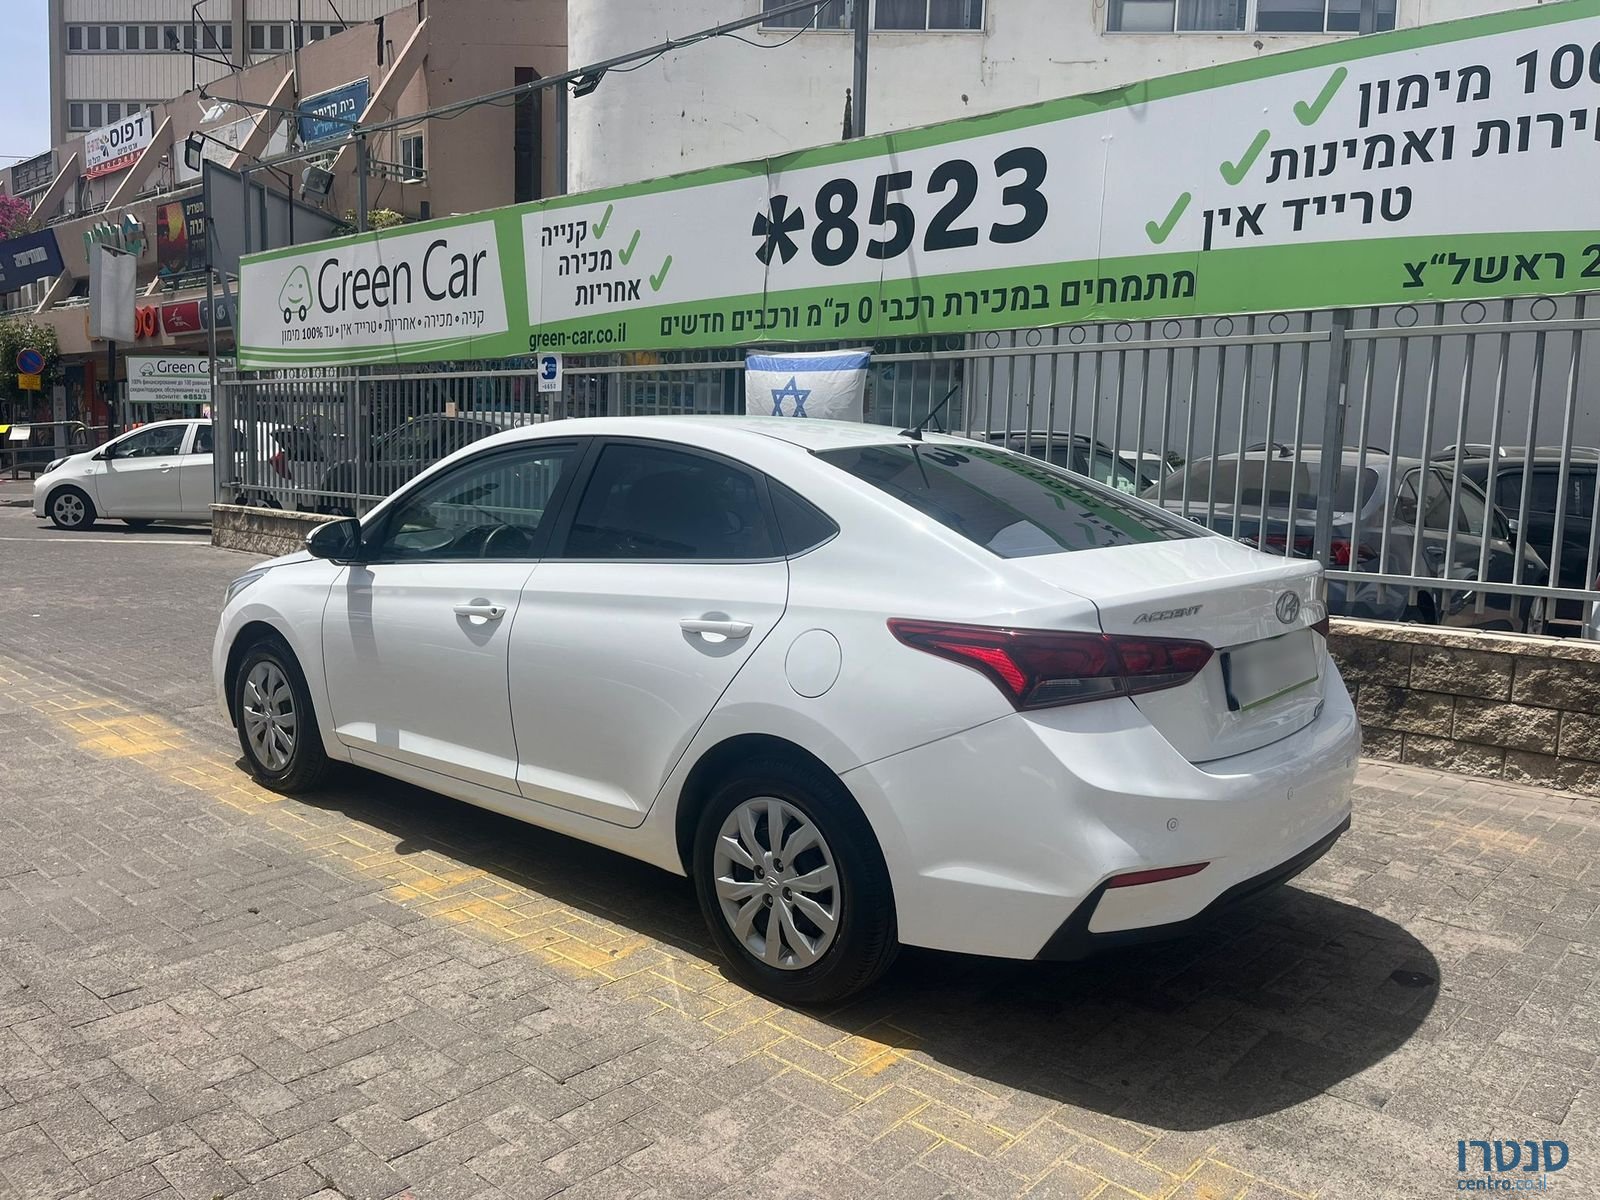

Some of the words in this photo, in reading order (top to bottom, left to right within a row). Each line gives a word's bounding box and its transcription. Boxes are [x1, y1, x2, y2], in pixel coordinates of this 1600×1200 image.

[1516, 41, 1600, 94] 10
[340, 98, 355, 113] בית
[1358, 65, 1491, 128] מימון
[109, 117, 144, 148] דפוס
[1472, 107, 1600, 158] ירות
[1265, 125, 1456, 184] ואמינות
[1282, 186, 1413, 233] טרייד
[541, 220, 588, 248] קנייה
[1202, 202, 1268, 252] אין
[559, 248, 613, 276] מכירה
[317, 257, 412, 315] Green
[422, 239, 487, 301] Car
[1060, 270, 1196, 307] מתמחים
[575, 278, 642, 307] אחריות
[942, 284, 1051, 318] במכירת
[424, 312, 453, 329] מכירה
[461, 310, 485, 329] קניה
[731, 307, 800, 332] ורכבים
[858, 296, 874, 324] 0
[880, 295, 935, 322] רכבי
[281, 329, 300, 345] מימון
[302, 326, 323, 341] 100%
[324, 325, 334, 338] עד
[340, 323, 353, 340] אין
[354, 320, 377, 335] טרייד
[384, 316, 416, 332] אחריות
[528, 322, 627, 352] green-car.co.il
[660, 311, 725, 337] חדשים
[157, 359, 195, 374] Green
[1132, 604, 1204, 625] ACCENT
